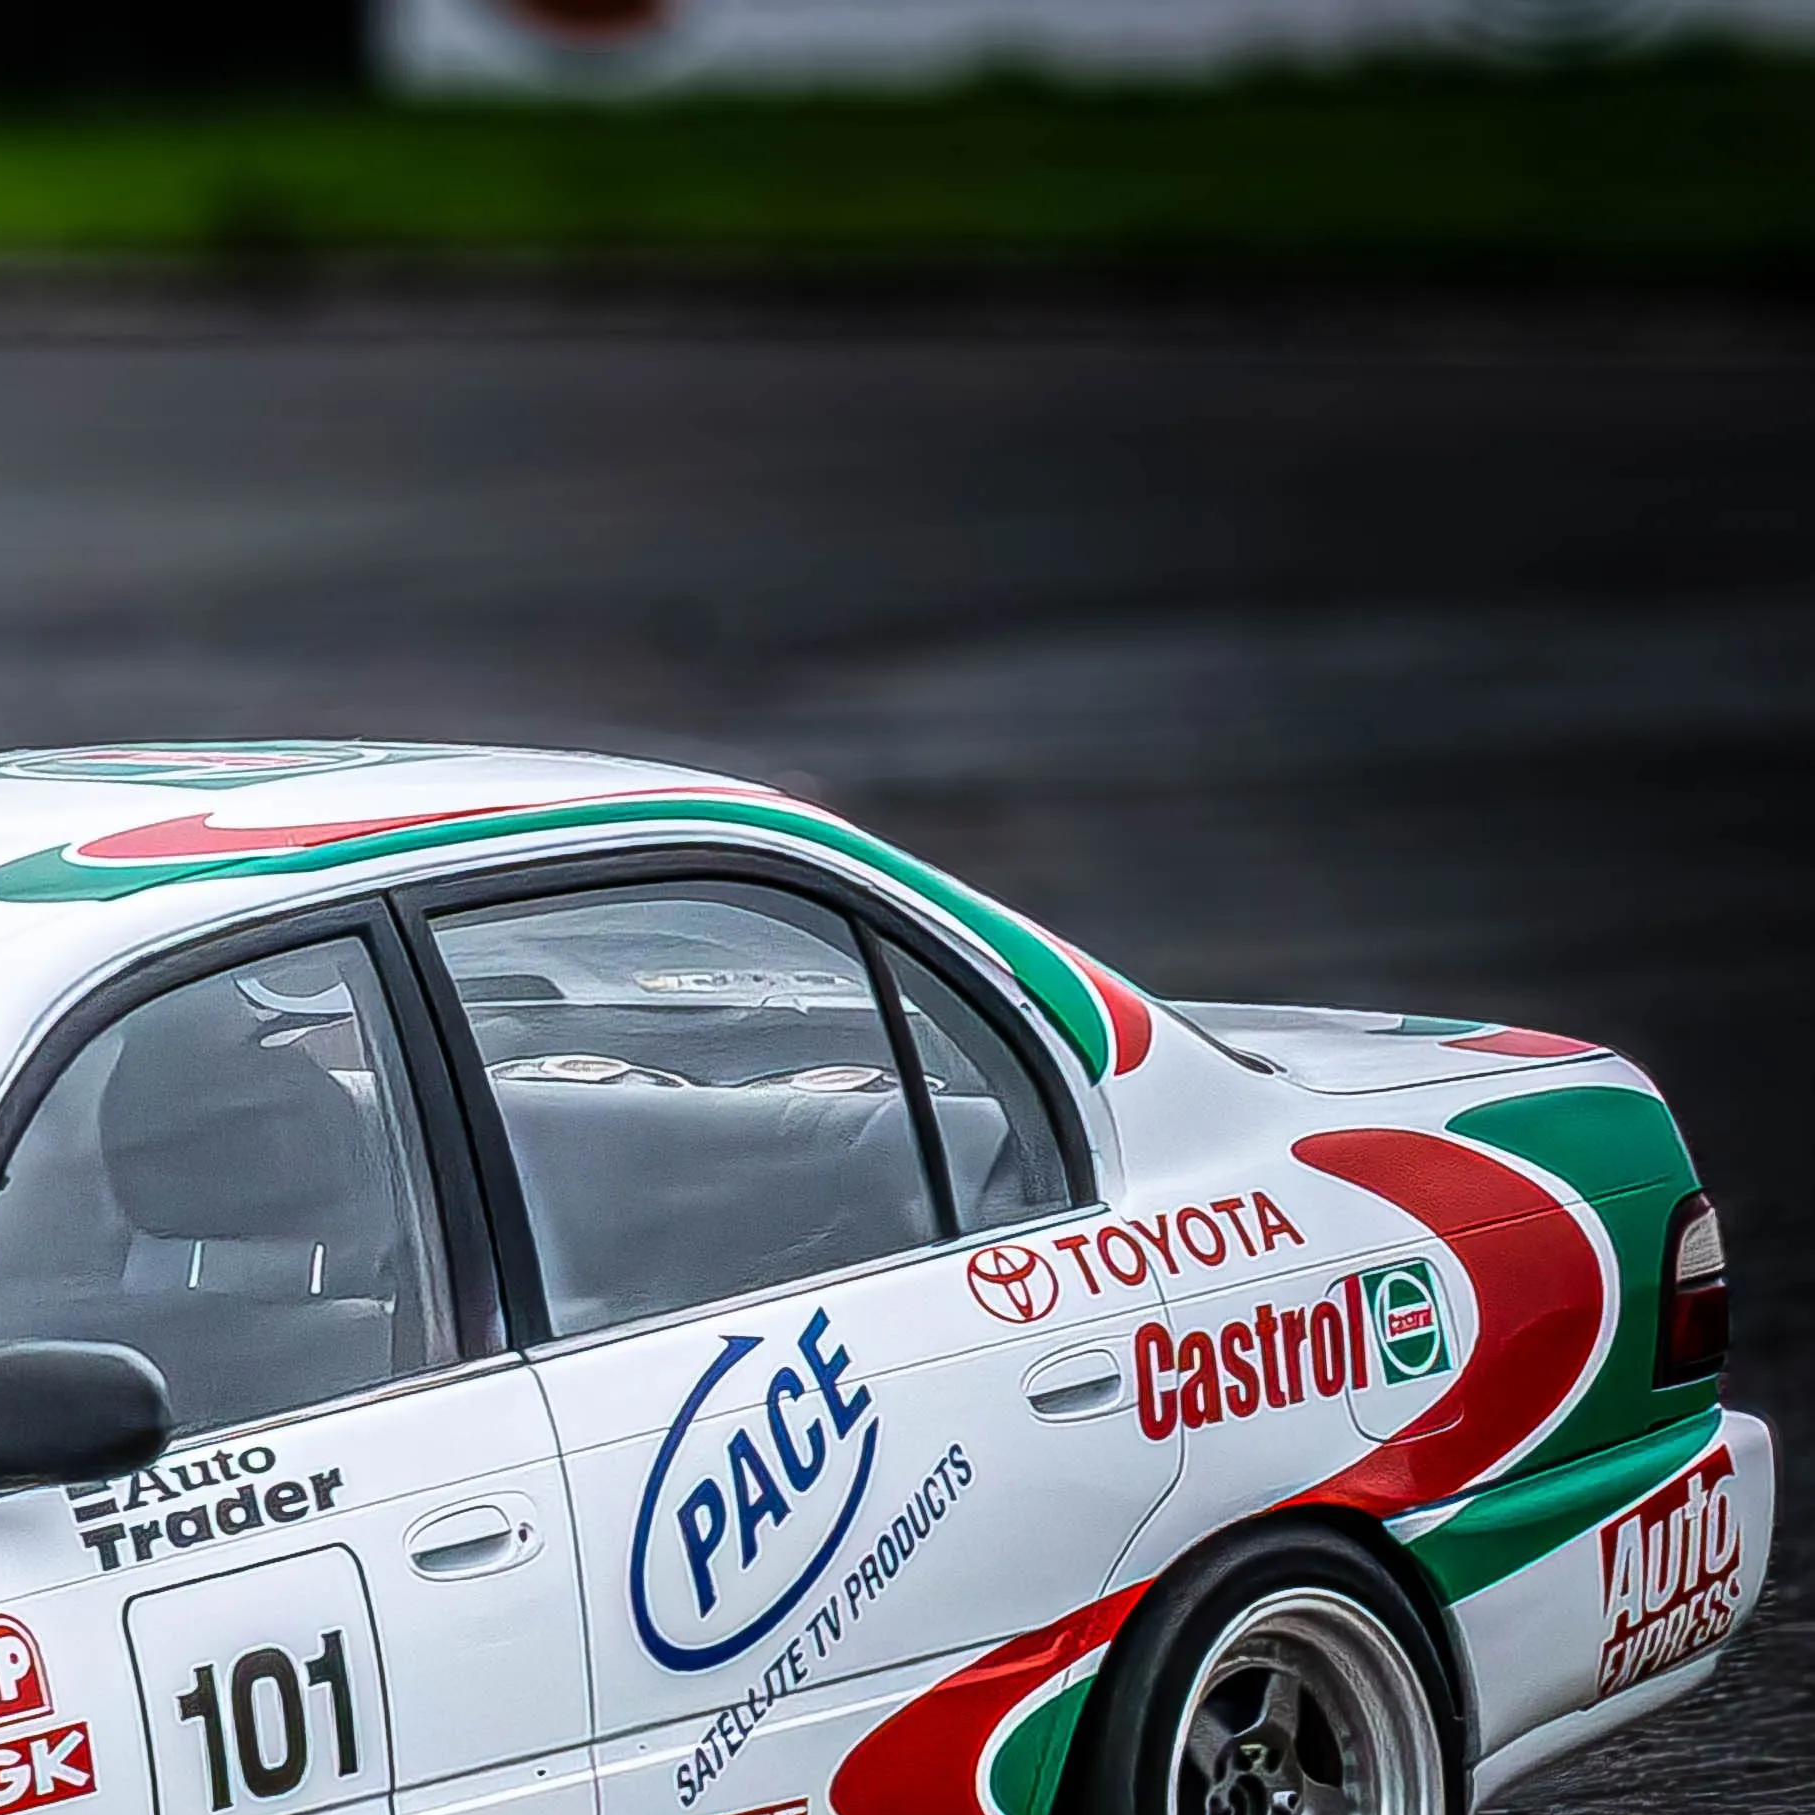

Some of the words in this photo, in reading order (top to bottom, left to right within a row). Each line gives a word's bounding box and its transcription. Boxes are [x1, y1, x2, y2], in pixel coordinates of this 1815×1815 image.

[1053, 1190, 1306, 1295] TOYOTA
[1132, 1273, 1368, 1441] Castrol
[79, 1467, 344, 1572] Trader
[122, 1446, 276, 1512] Auto
[673, 1306, 875, 1619] PACE
[675, 1636, 811, 1807] SATELLITE
[804, 1599, 845, 1660] TV
[843, 1443, 974, 1623] PRODUCTS
[176, 1628, 360, 1812] 101
